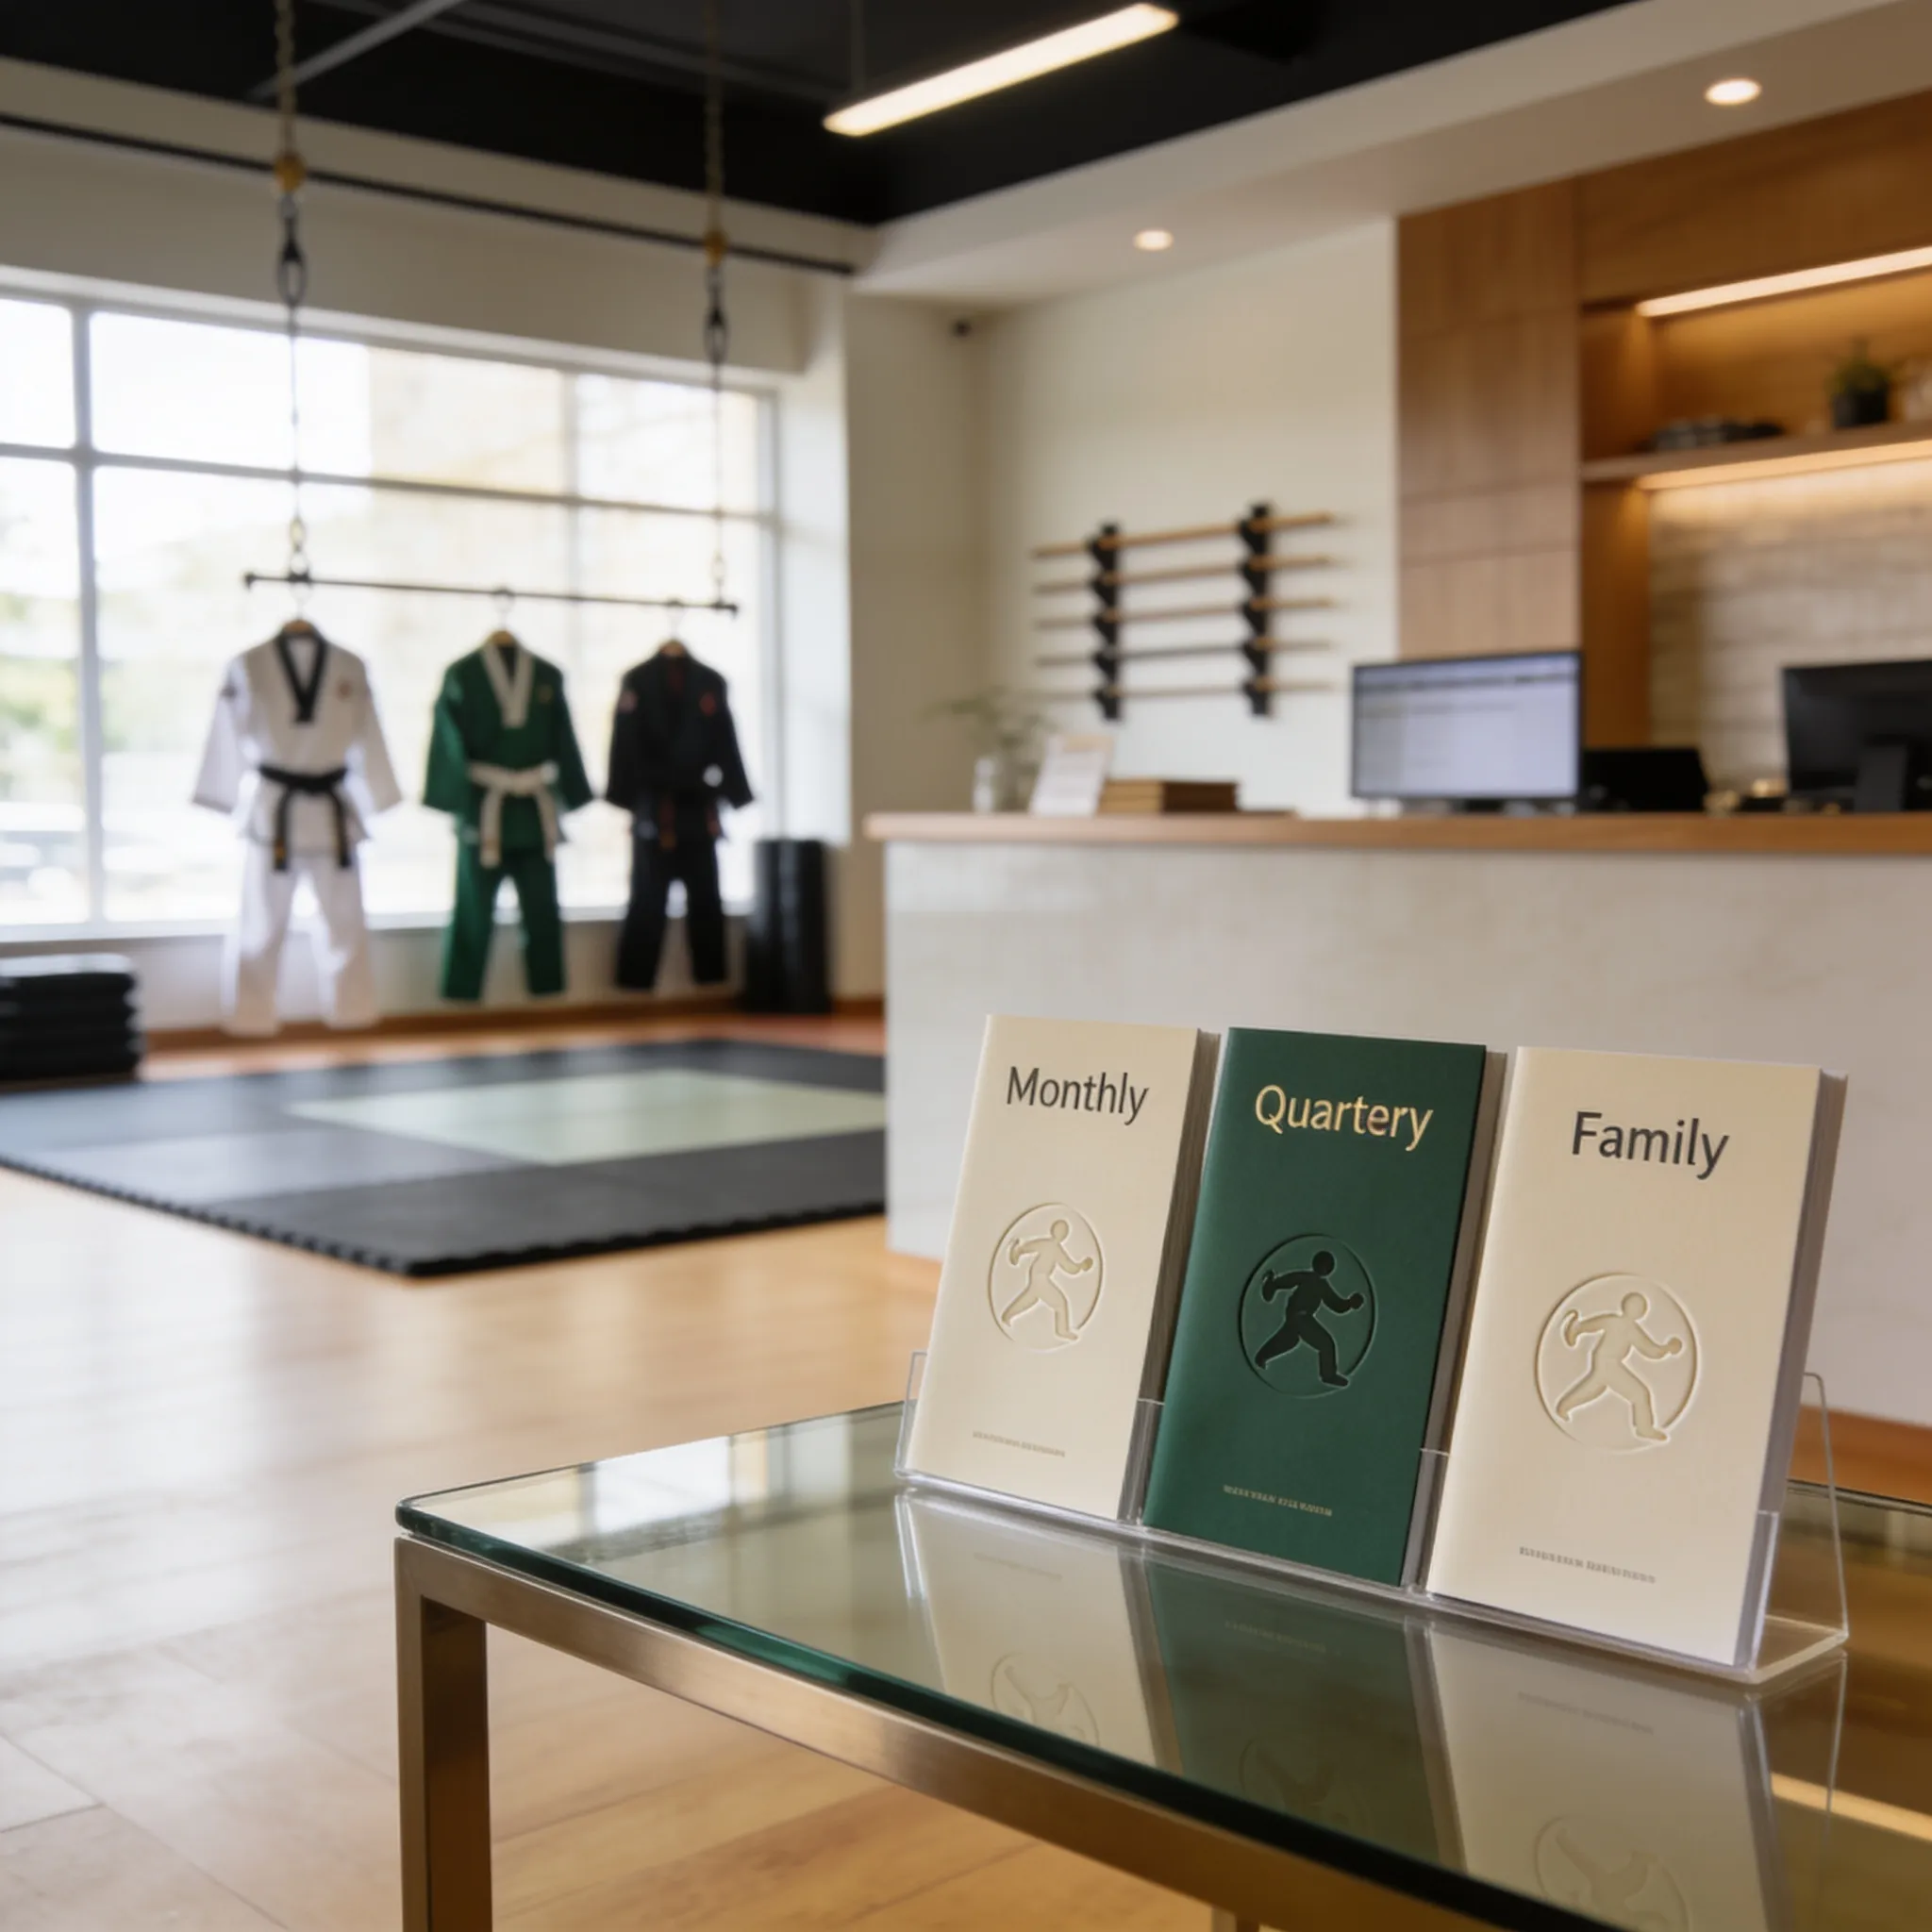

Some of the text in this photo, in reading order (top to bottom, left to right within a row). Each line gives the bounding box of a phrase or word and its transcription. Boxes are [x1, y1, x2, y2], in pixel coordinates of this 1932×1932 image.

[1006, 1065, 1150, 1126] Monthly
[1255, 1084, 1434, 1152] Quartery
[1572, 1110, 1730, 1180] Family
